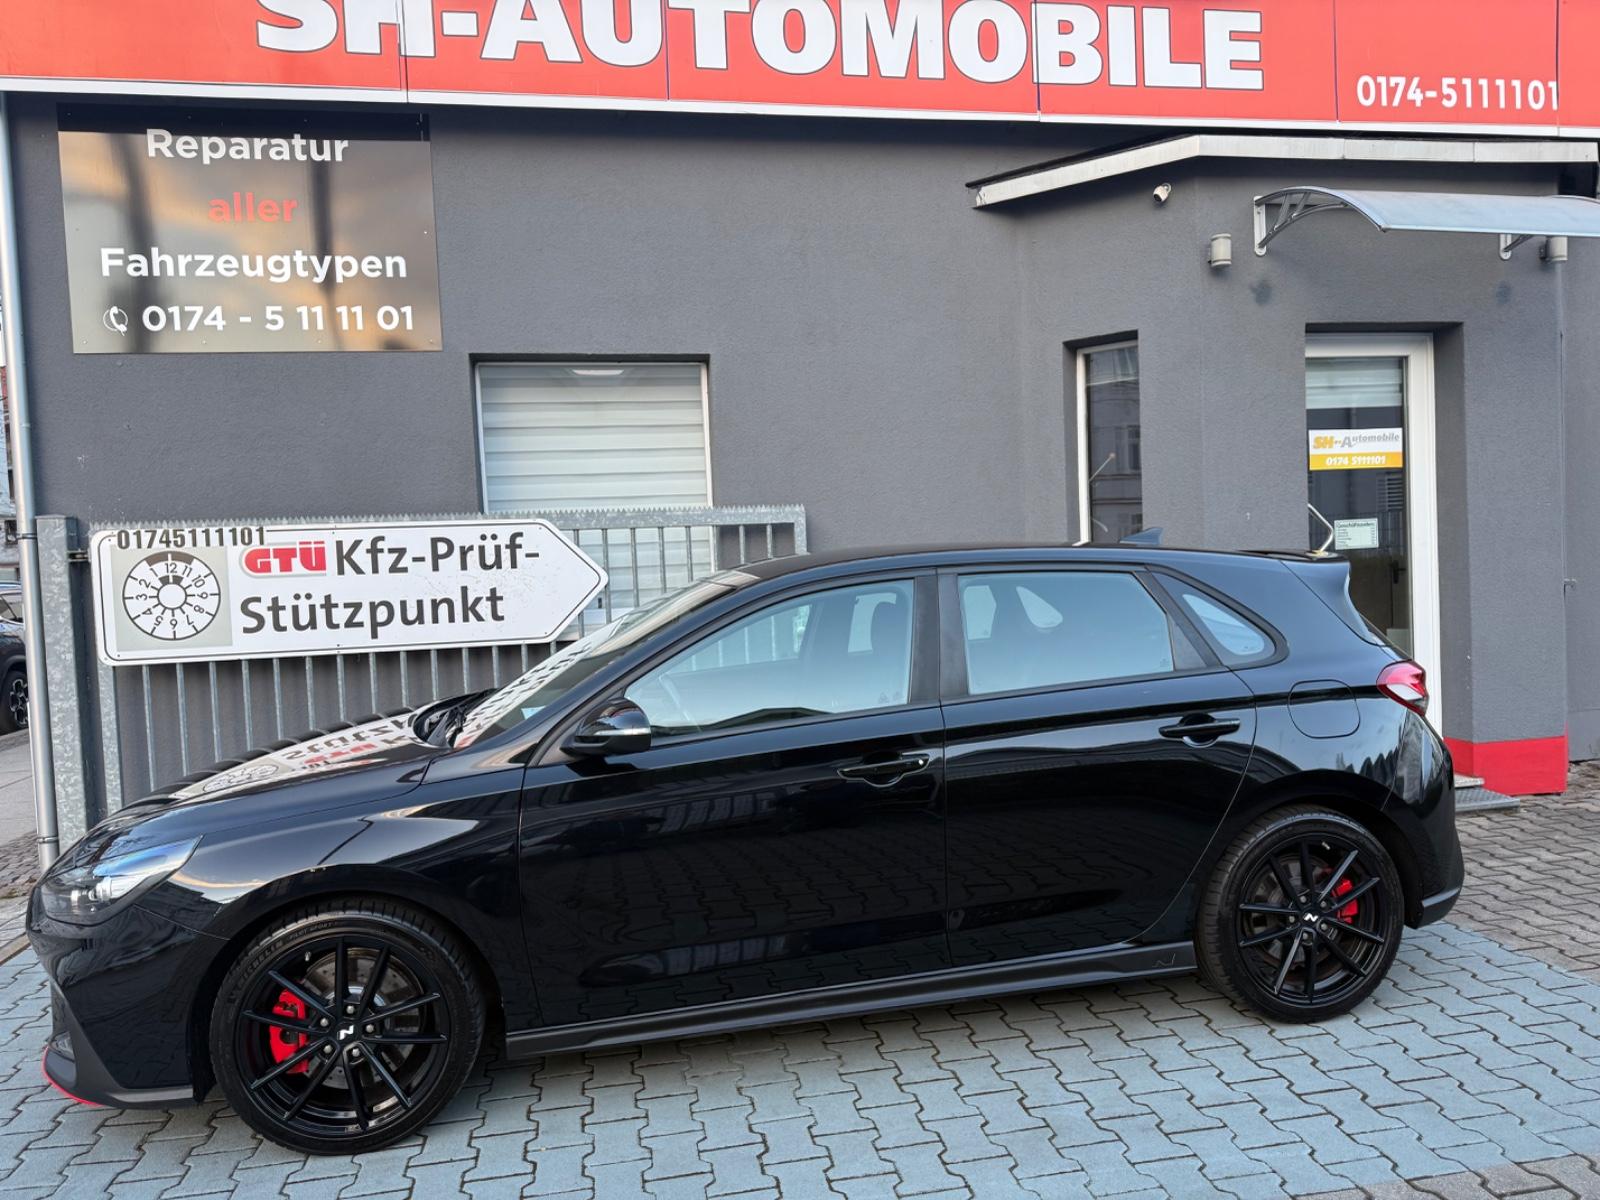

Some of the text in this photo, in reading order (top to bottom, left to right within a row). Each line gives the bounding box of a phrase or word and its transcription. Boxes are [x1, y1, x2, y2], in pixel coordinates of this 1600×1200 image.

[256, 0, 1264, 91] SH-AUTOMOBILE
[1356, 75, 1560, 111] 0174-5111101
[146, 128, 349, 165] Reparatur
[208, 193, 298, 223] aller
[100, 247, 408, 284] Fahrzeugtypen
[142, 305, 226, 332] 0174
[264, 306, 285, 331] 5
[297, 306, 325, 330] 11
[336, 306, 364, 330] 11
[376, 305, 414, 331] 01
[117, 527, 265, 549] 01745111101
[244, 532, 540, 576] GTÜ Kfz-Prüf-
[240, 586, 506, 640] Stützpunkt
